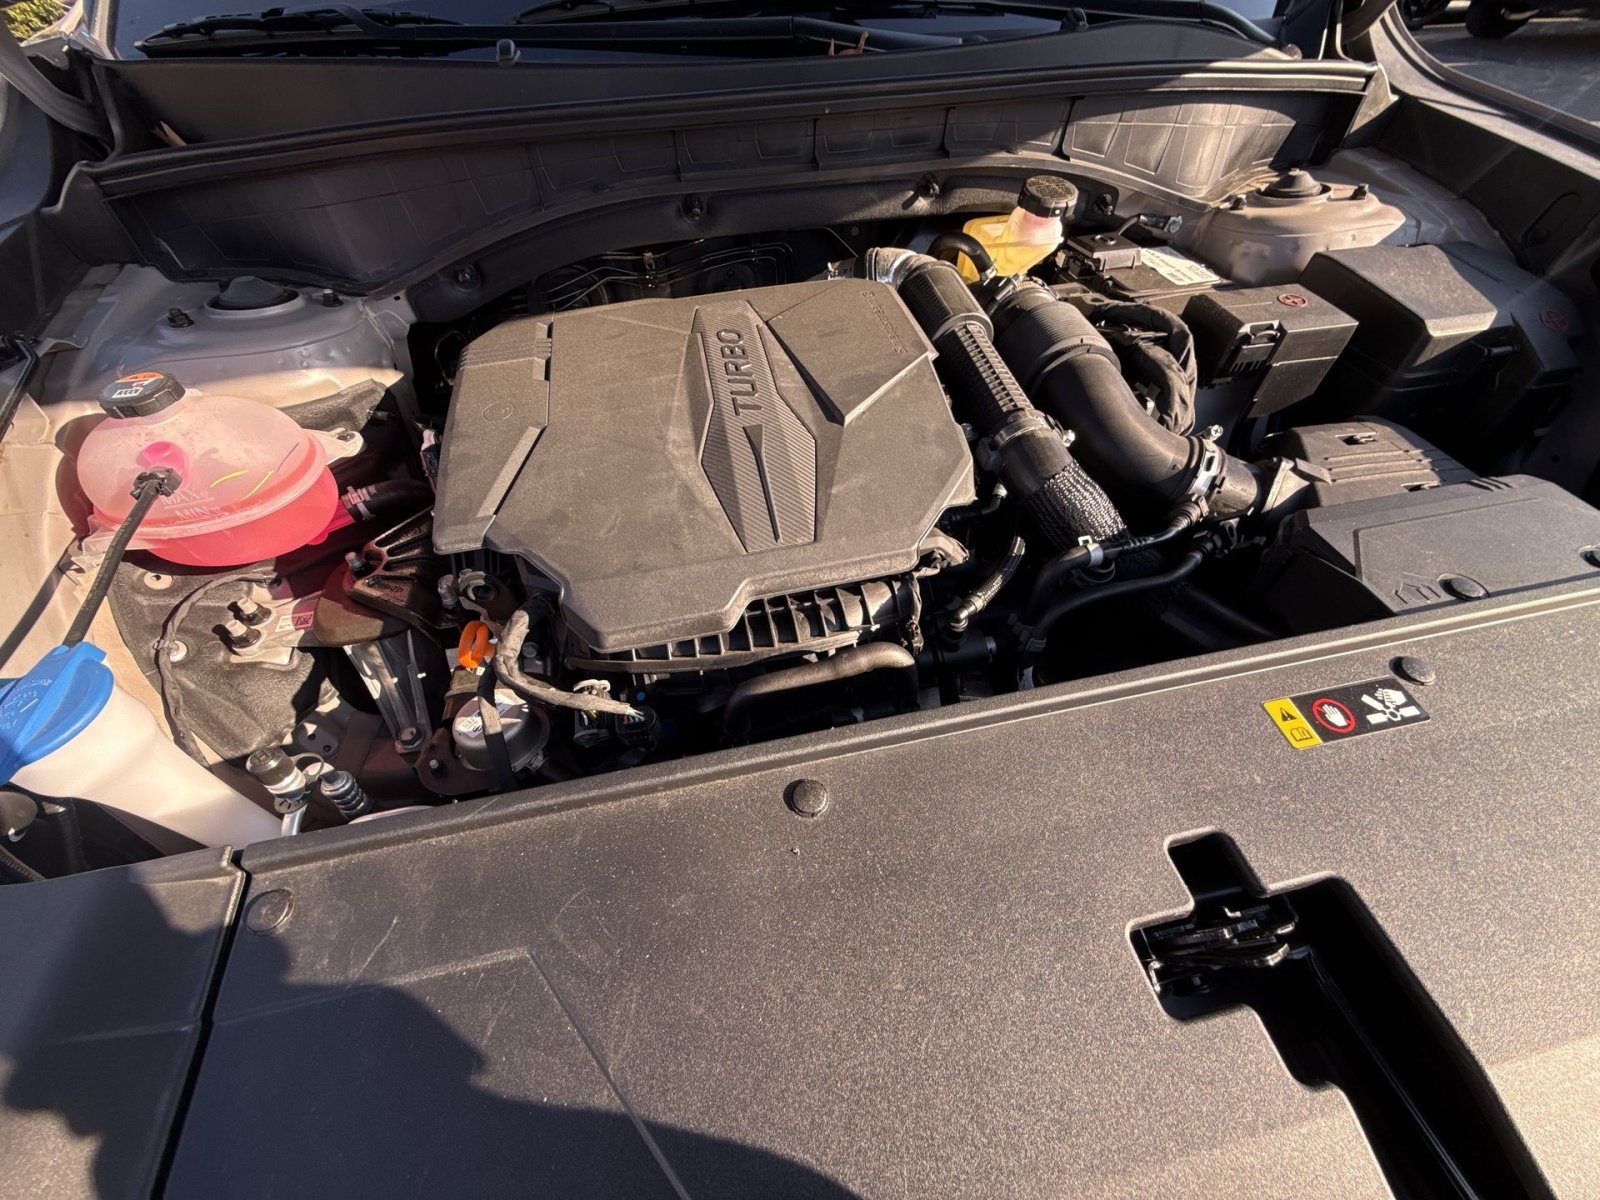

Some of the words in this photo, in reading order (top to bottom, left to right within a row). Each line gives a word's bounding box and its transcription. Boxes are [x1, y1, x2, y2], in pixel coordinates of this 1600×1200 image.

[717, 328, 763, 416] TURBO
[160, 488, 201, 506] MAX
[174, 506, 209, 521] MIN
